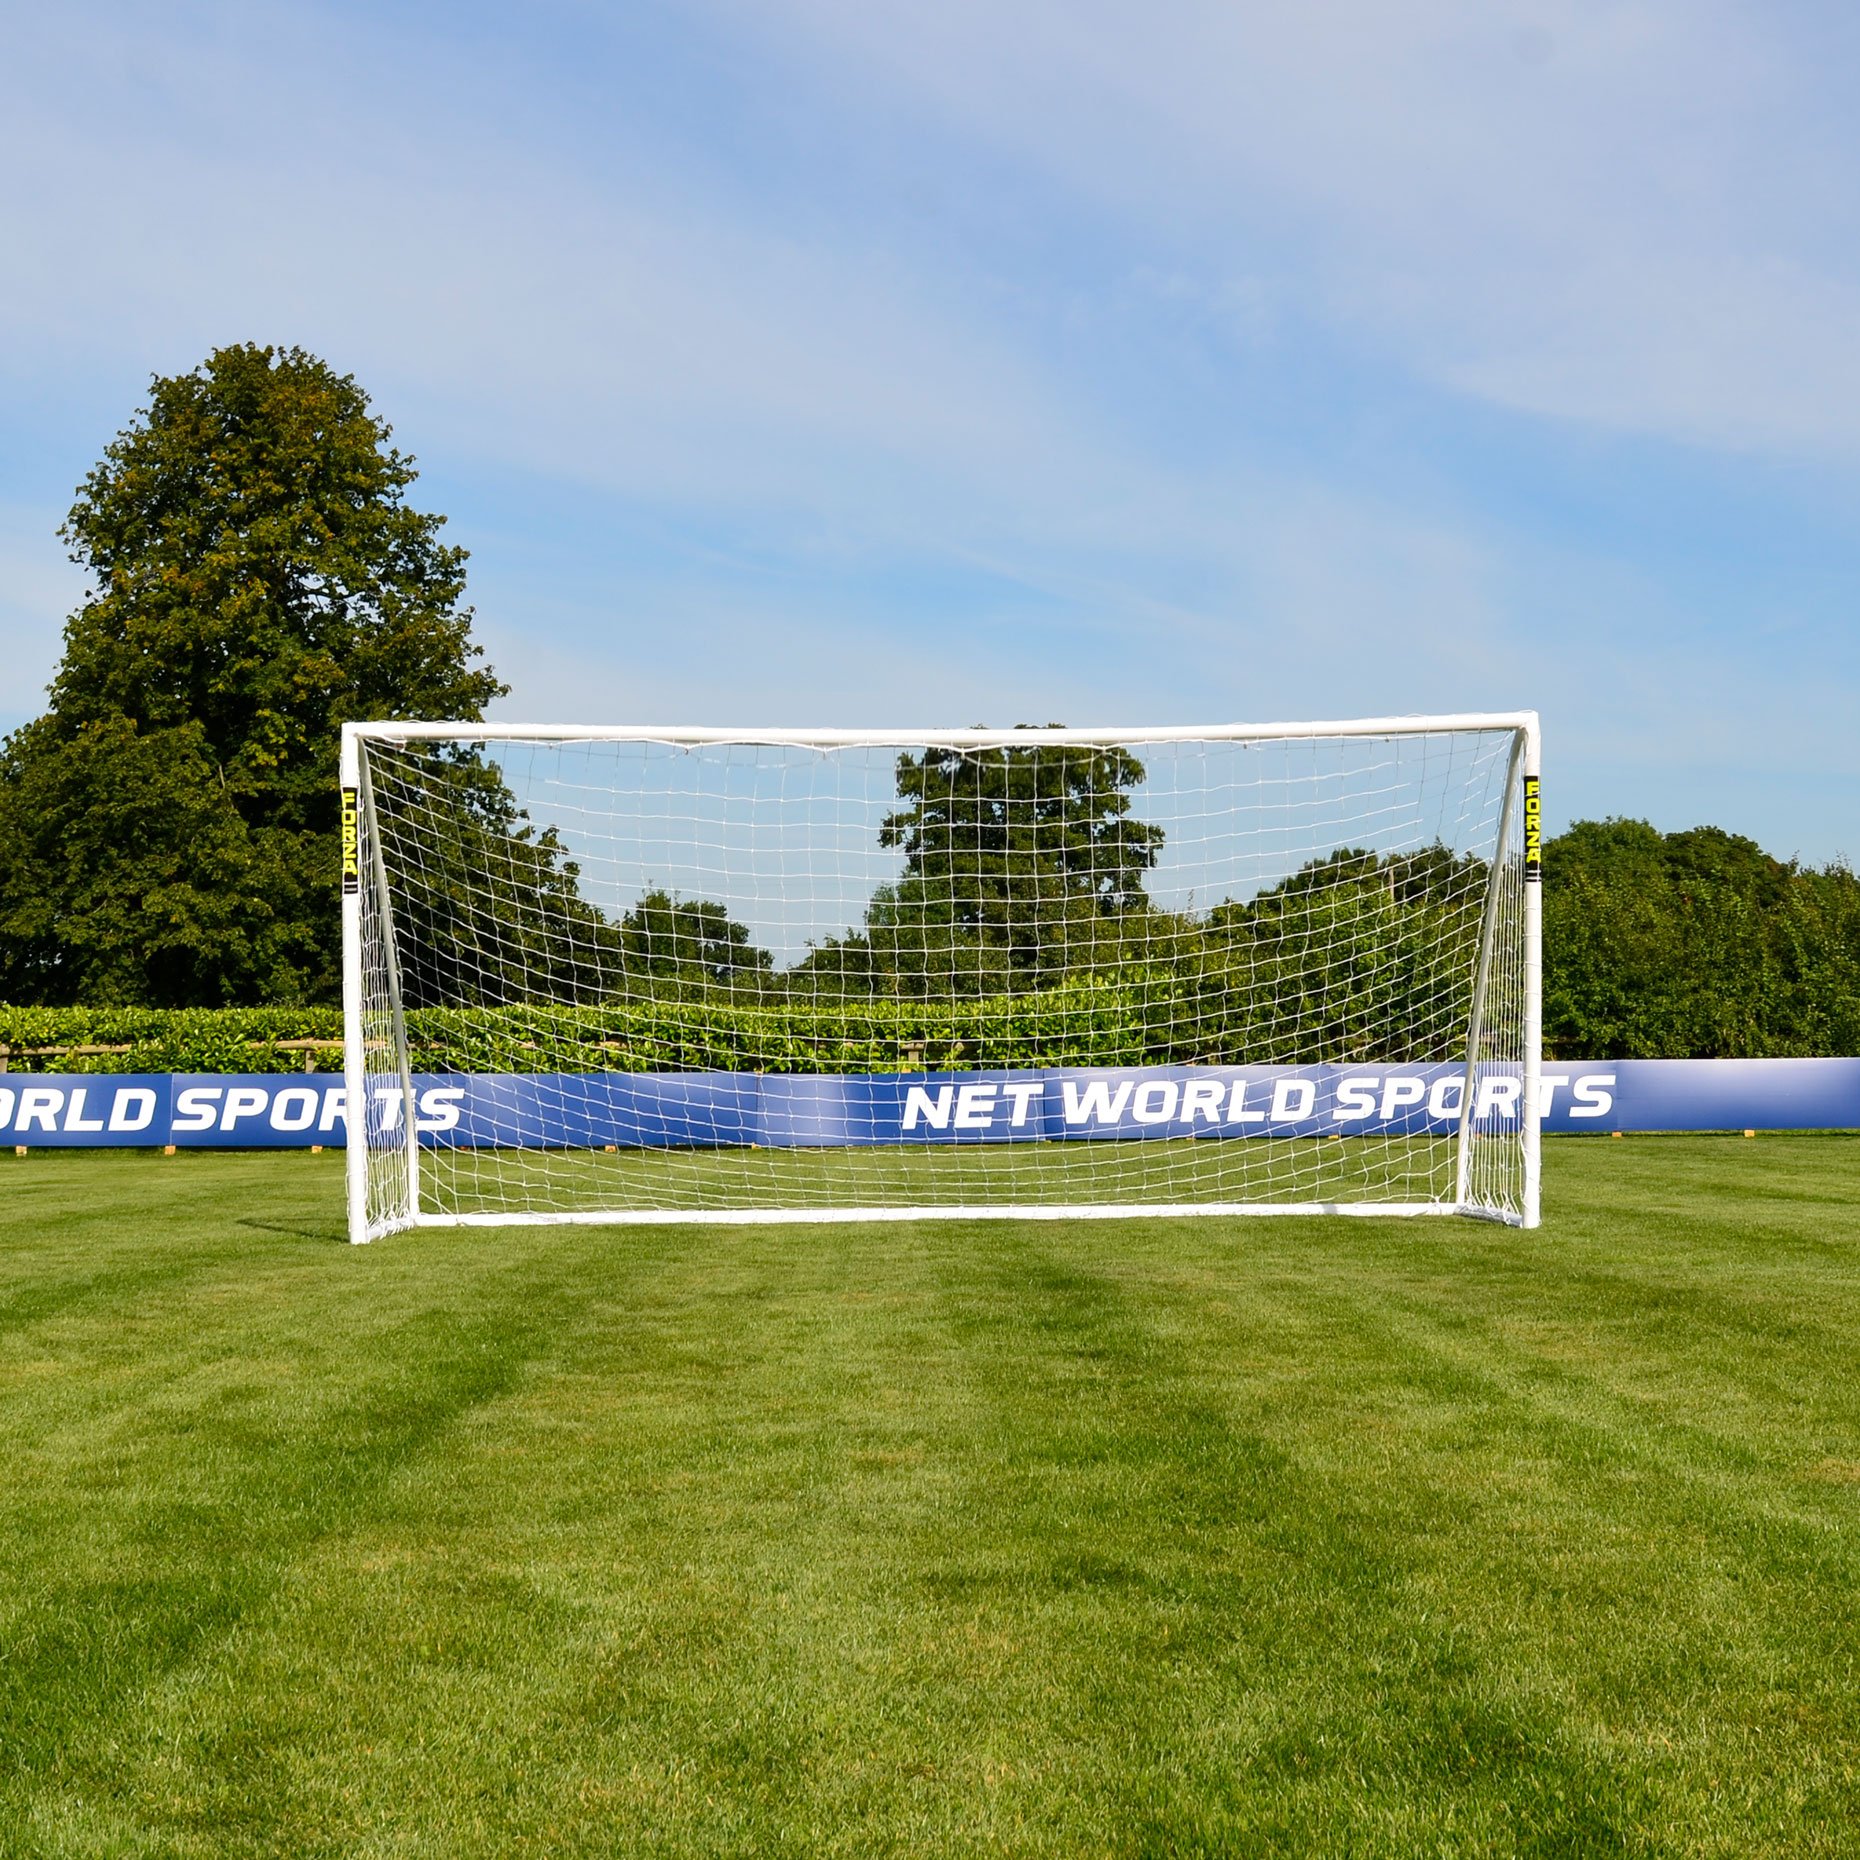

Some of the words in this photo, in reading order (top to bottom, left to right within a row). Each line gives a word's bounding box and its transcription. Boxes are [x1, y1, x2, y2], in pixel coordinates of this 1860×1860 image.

[342, 792, 358, 875] FORZA
[1526, 781, 1541, 863] FORZA
[902, 1083, 1044, 1130] NET
[1062, 1080, 1315, 1124] WORLD
[1332, 1074, 1616, 1119] SPORTS
